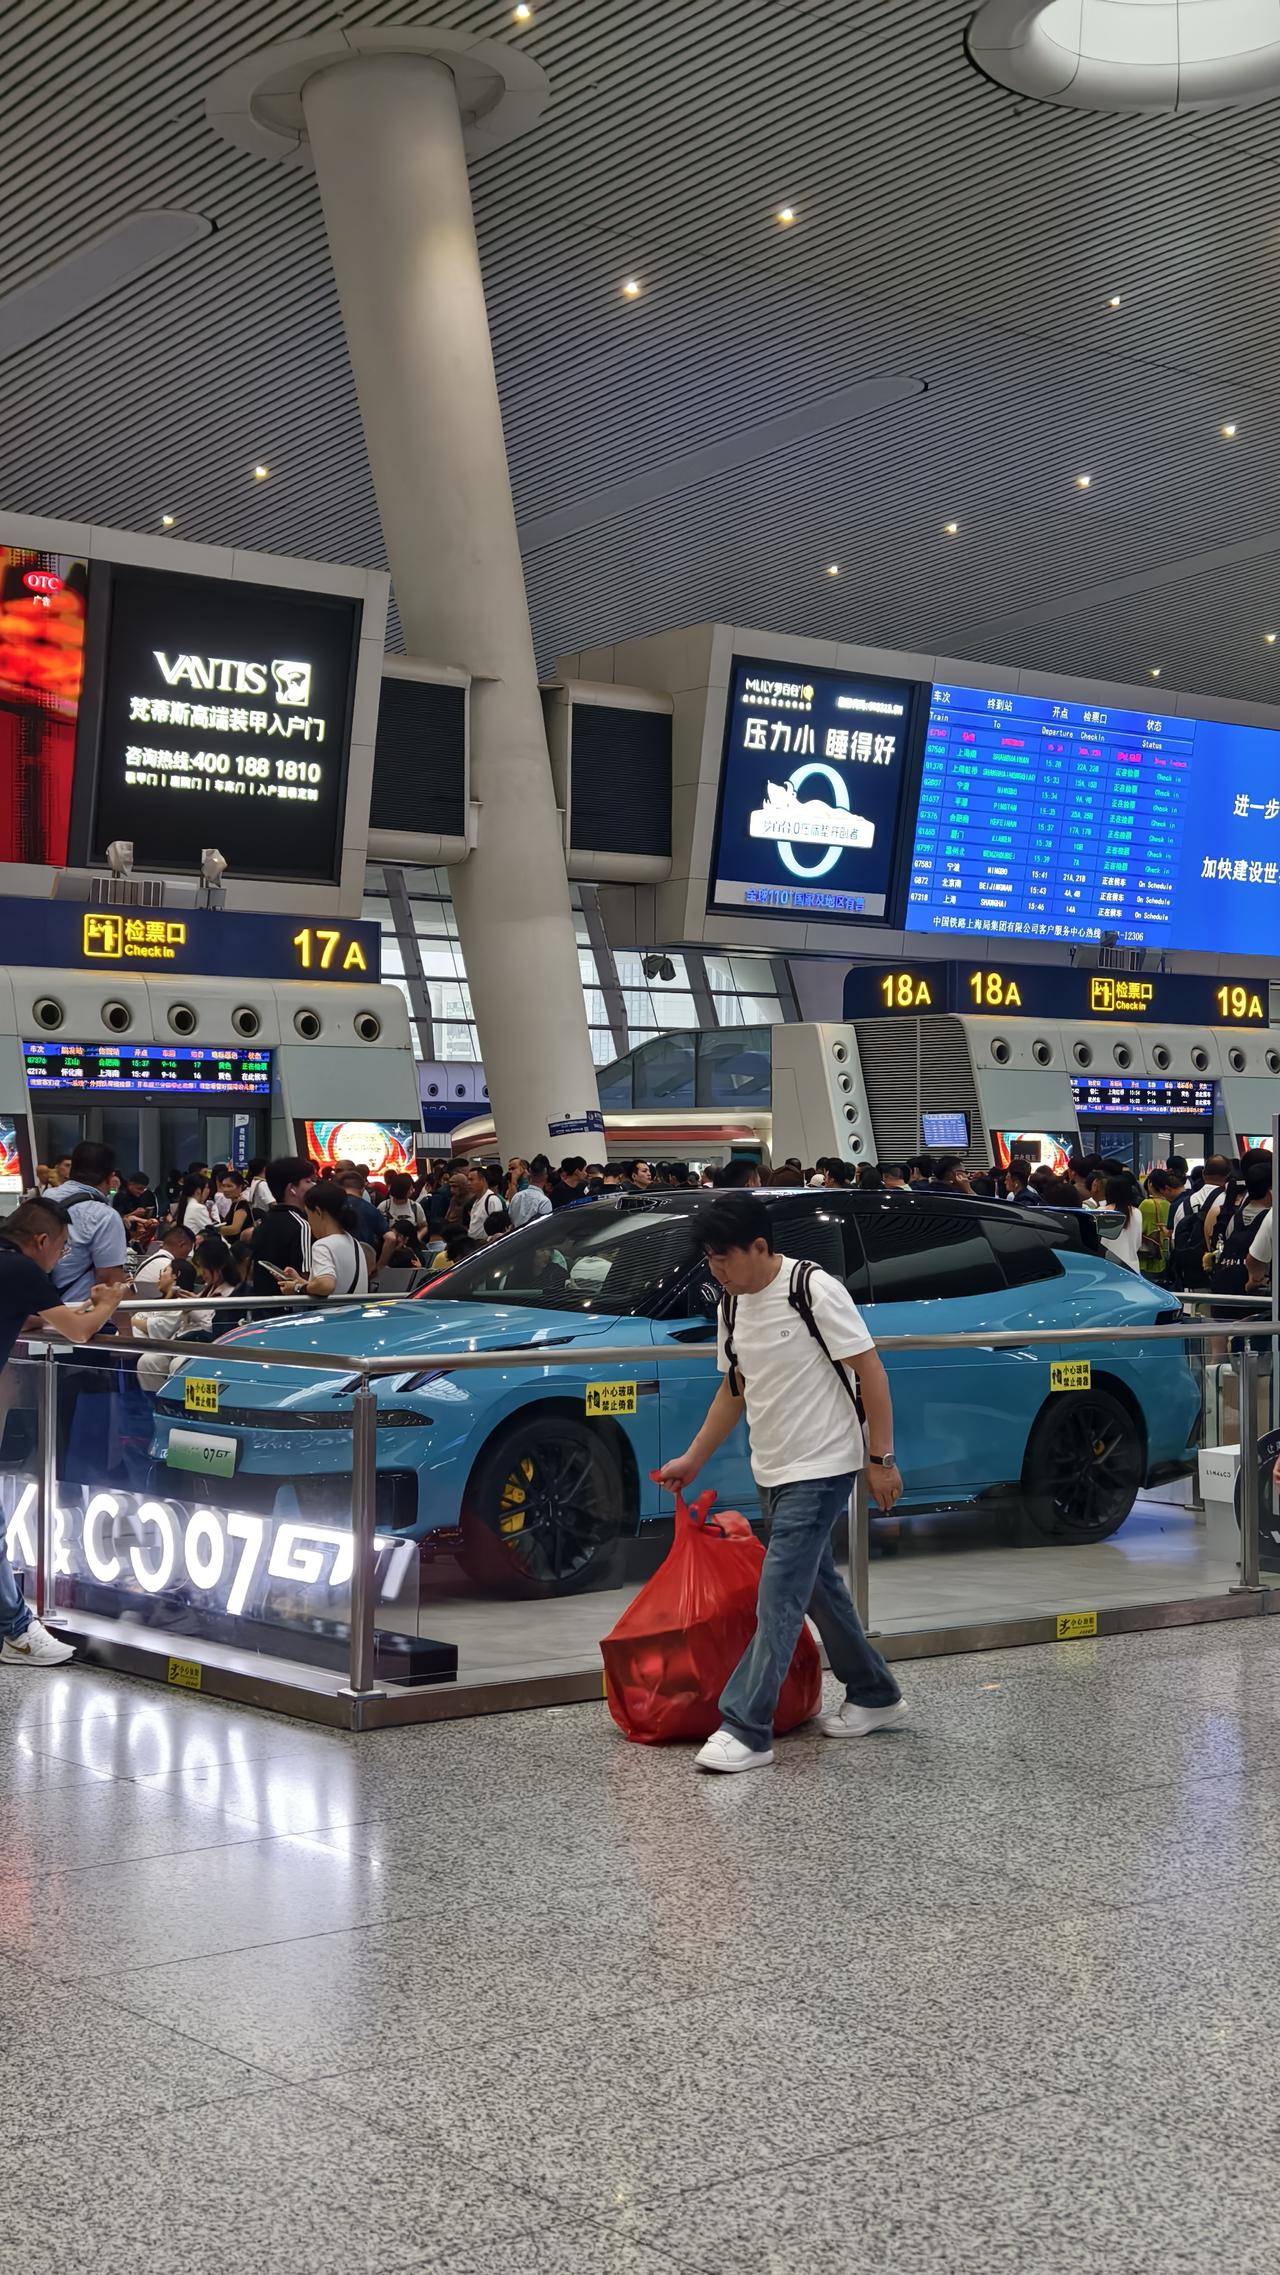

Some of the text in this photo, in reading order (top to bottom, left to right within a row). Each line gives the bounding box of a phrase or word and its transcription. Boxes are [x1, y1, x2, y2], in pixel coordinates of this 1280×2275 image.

[28, 574, 59, 590] OTC
[153, 651, 267, 694] VANTIS
[129, 696, 326, 742] 梵蒂斯高端装甲入户门
[934, 690, 1162, 732] 车次 终到站 开点 检票口 状态
[743, 717, 896, 765] 压力小 睡得好
[930, 711, 949, 722] Train
[993, 720, 1001, 729] To
[1041, 726, 1074, 738] Departure
[1142, 740, 1162, 750] Status
[236, 755, 270, 778] 188
[275, 759, 322, 783] 1810
[1032, 870, 1048, 879] 15:41
[1147, 881, 1173, 891] Schedule
[1200, 856, 1280, 884] 加快建设世
[1030, 886, 1047, 896] 15:43
[1145, 897, 1171, 906] Schedule
[1143, 912, 1169, 922] Schedule
[124, 919, 187, 945] 检票口
[293, 929, 368, 971] 17A
[882, 974, 932, 1008] 18A
[970, 971, 1022, 1006] 18A
[1116, 981, 1153, 1000] 检票口
[1217, 986, 1263, 1018] 19A
[131, 1059, 150, 1068] 15:37
[161, 1061, 177, 1069] 9-16
[161, 1071, 177, 1079] 9-16
[602, 1385, 634, 1398] 小心玻璃
